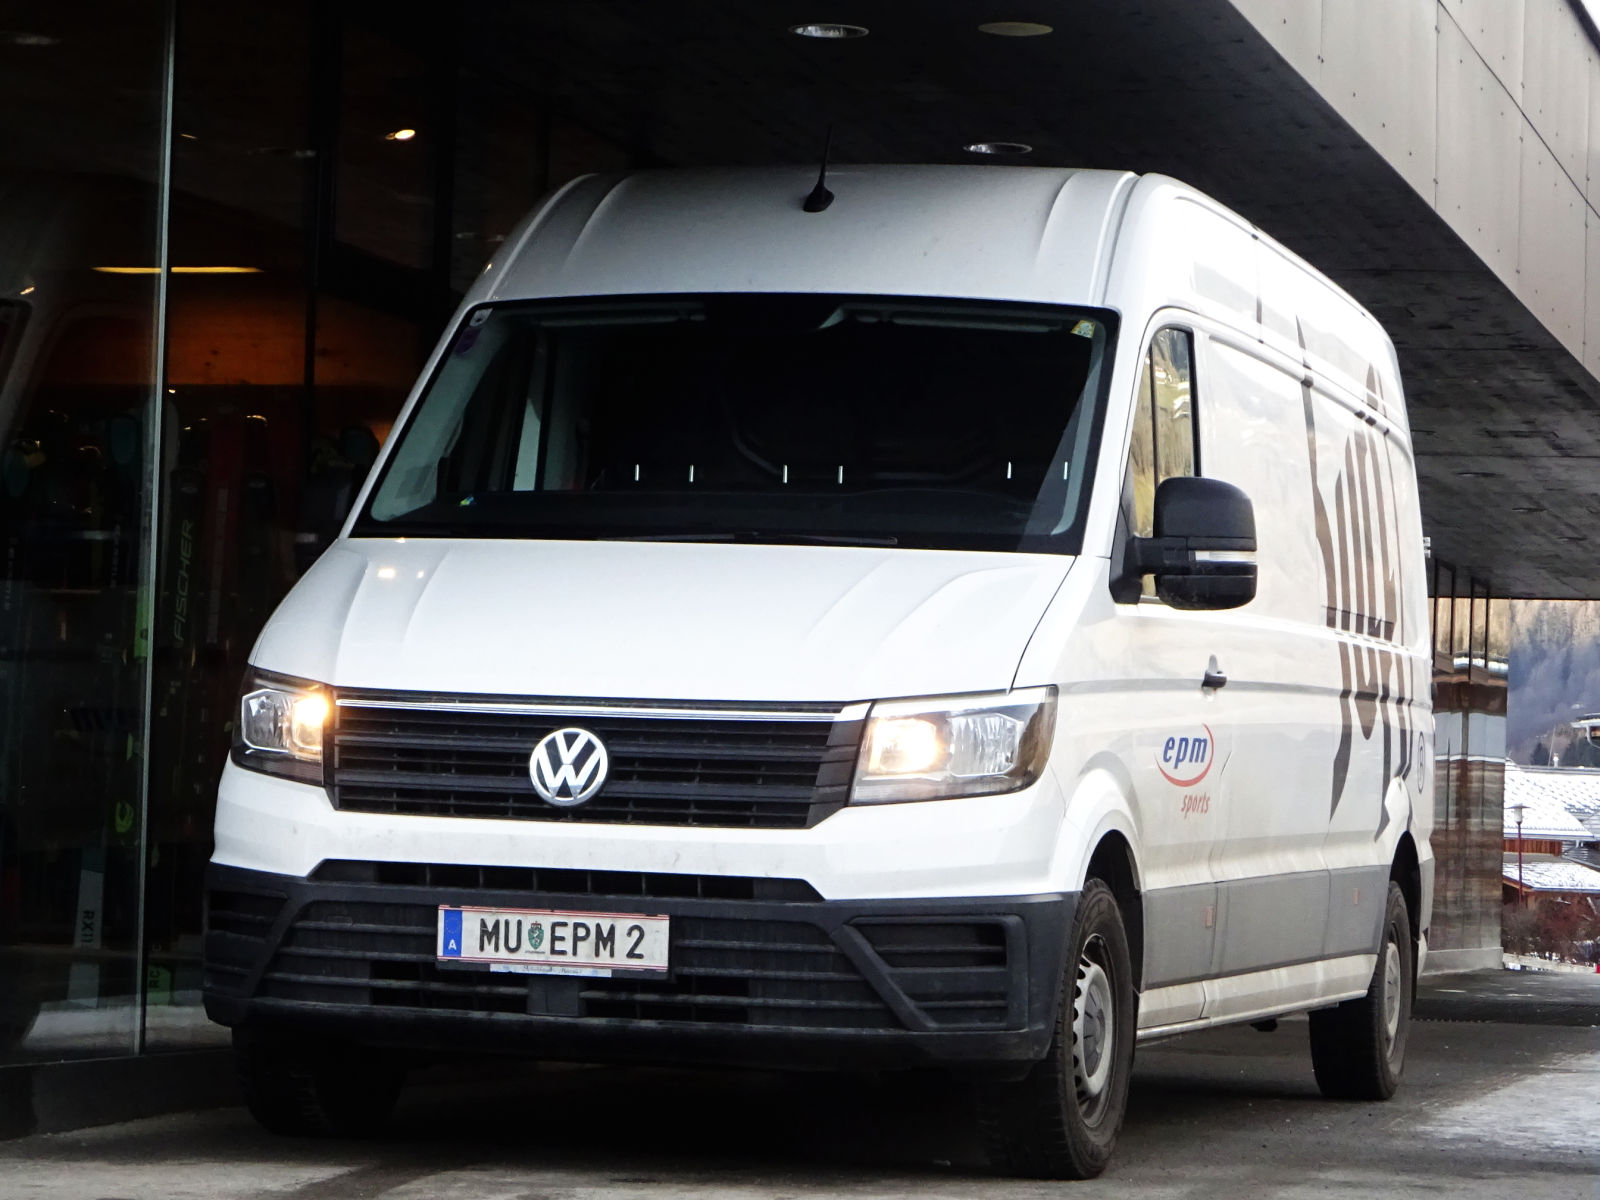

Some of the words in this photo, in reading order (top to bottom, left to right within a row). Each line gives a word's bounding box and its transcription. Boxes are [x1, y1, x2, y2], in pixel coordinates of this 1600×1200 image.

[173, 519, 194, 641] FISCHER
[1163, 737, 1208, 770] epm
[1181, 792, 1210, 819] sports
[447, 940, 458, 951] A
[479, 918, 522, 954] MU
[549, 921, 617, 959] EPM
[625, 923, 646, 960] 2
